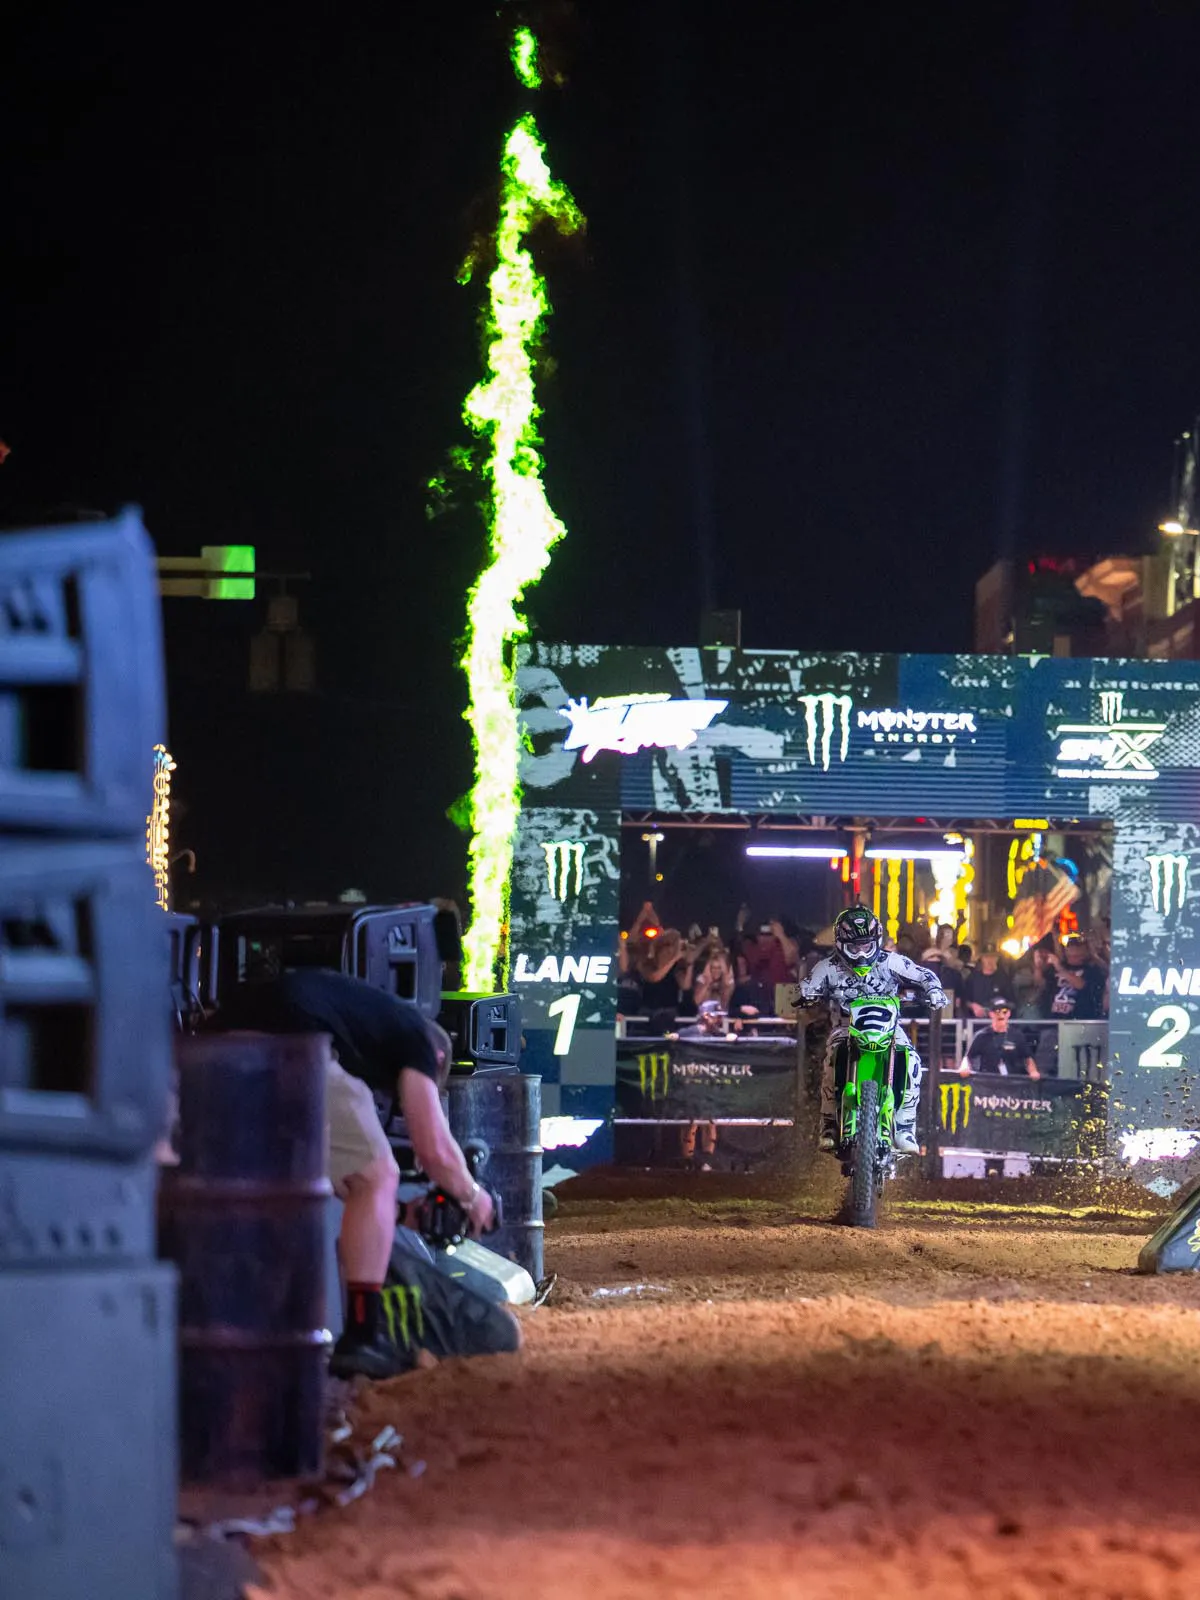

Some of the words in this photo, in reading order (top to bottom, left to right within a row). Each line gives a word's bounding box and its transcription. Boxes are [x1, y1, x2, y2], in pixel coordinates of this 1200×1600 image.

[857, 708, 977, 732] MONSTER
[873, 733, 957, 743] ENERGY
[514, 954, 612, 983] LANE
[548, 993, 581, 1056] 1
[855, 1006, 893, 1031] 2
[1138, 1004, 1191, 1068] 2
[672, 1062, 754, 1077] MONSTER
[973, 1094, 1053, 1112] MONSTER
